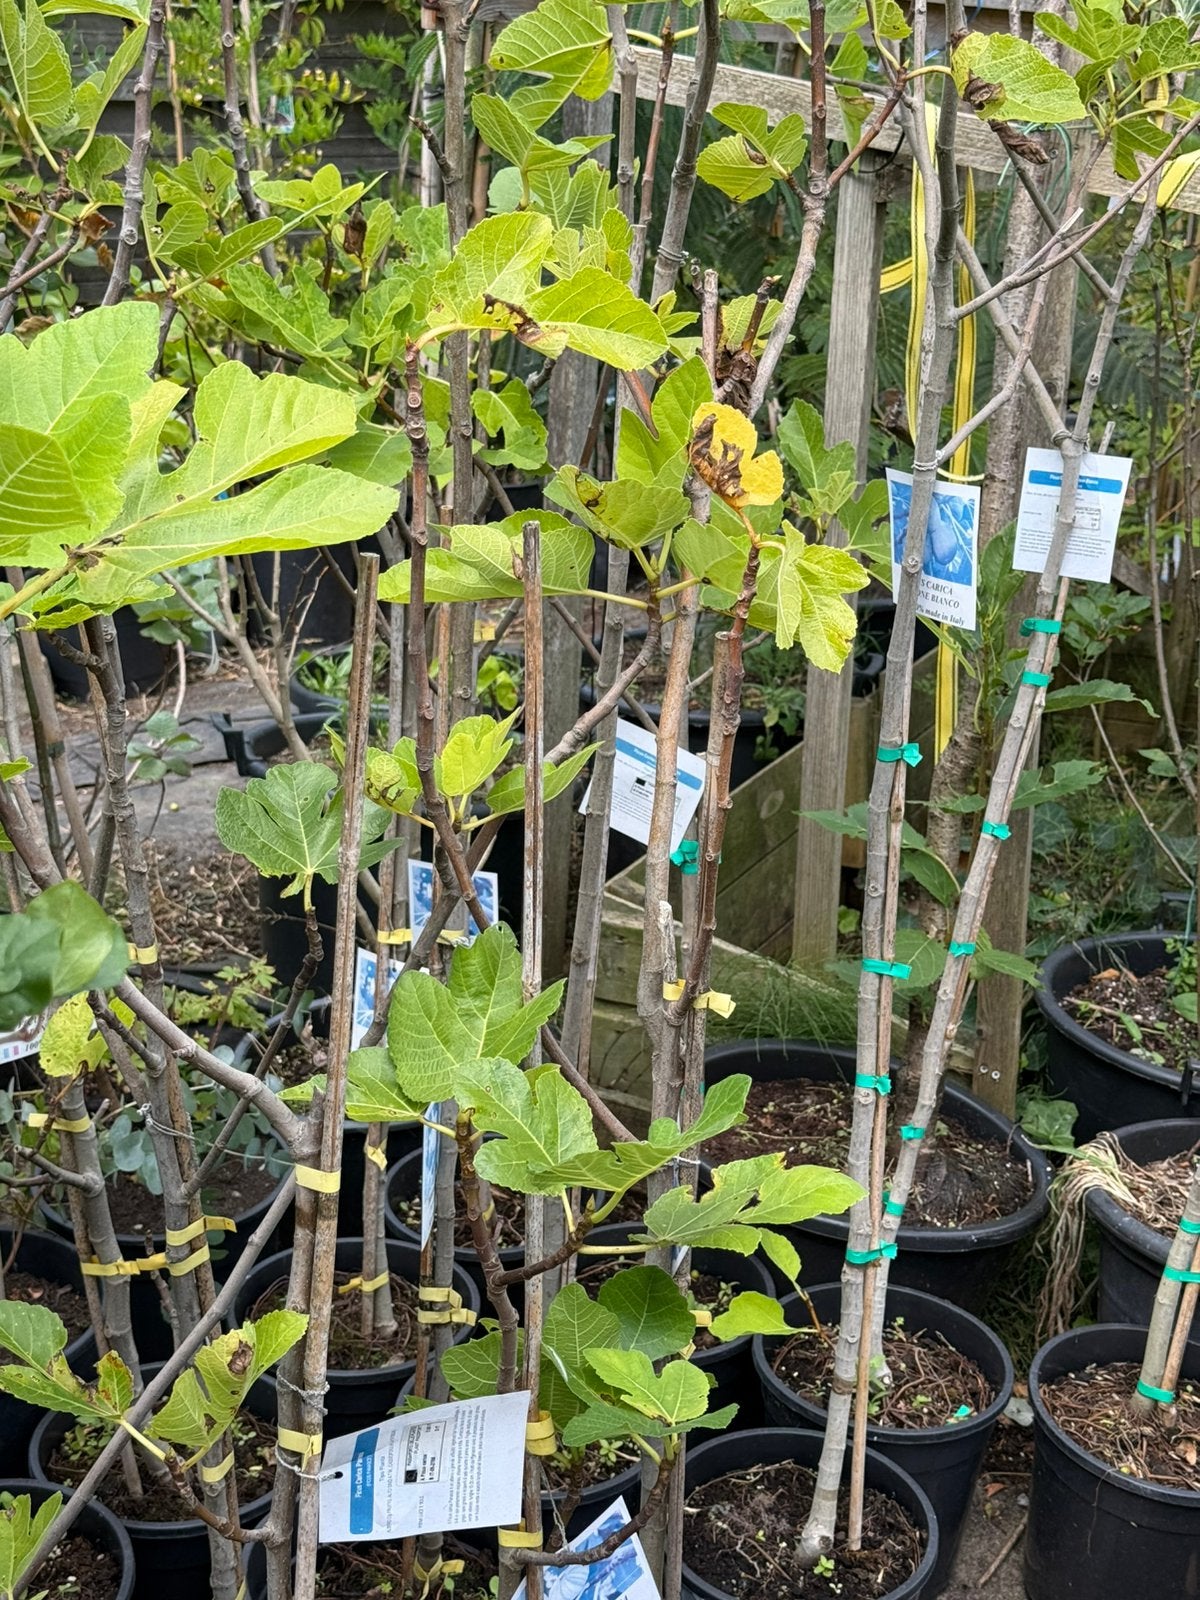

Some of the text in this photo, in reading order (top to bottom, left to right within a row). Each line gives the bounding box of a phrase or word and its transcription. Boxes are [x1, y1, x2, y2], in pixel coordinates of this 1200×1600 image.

[926, 581, 953, 595] CARICA
[931, 594, 959, 608] BIANCO
[950, 615, 964, 625] Italy
